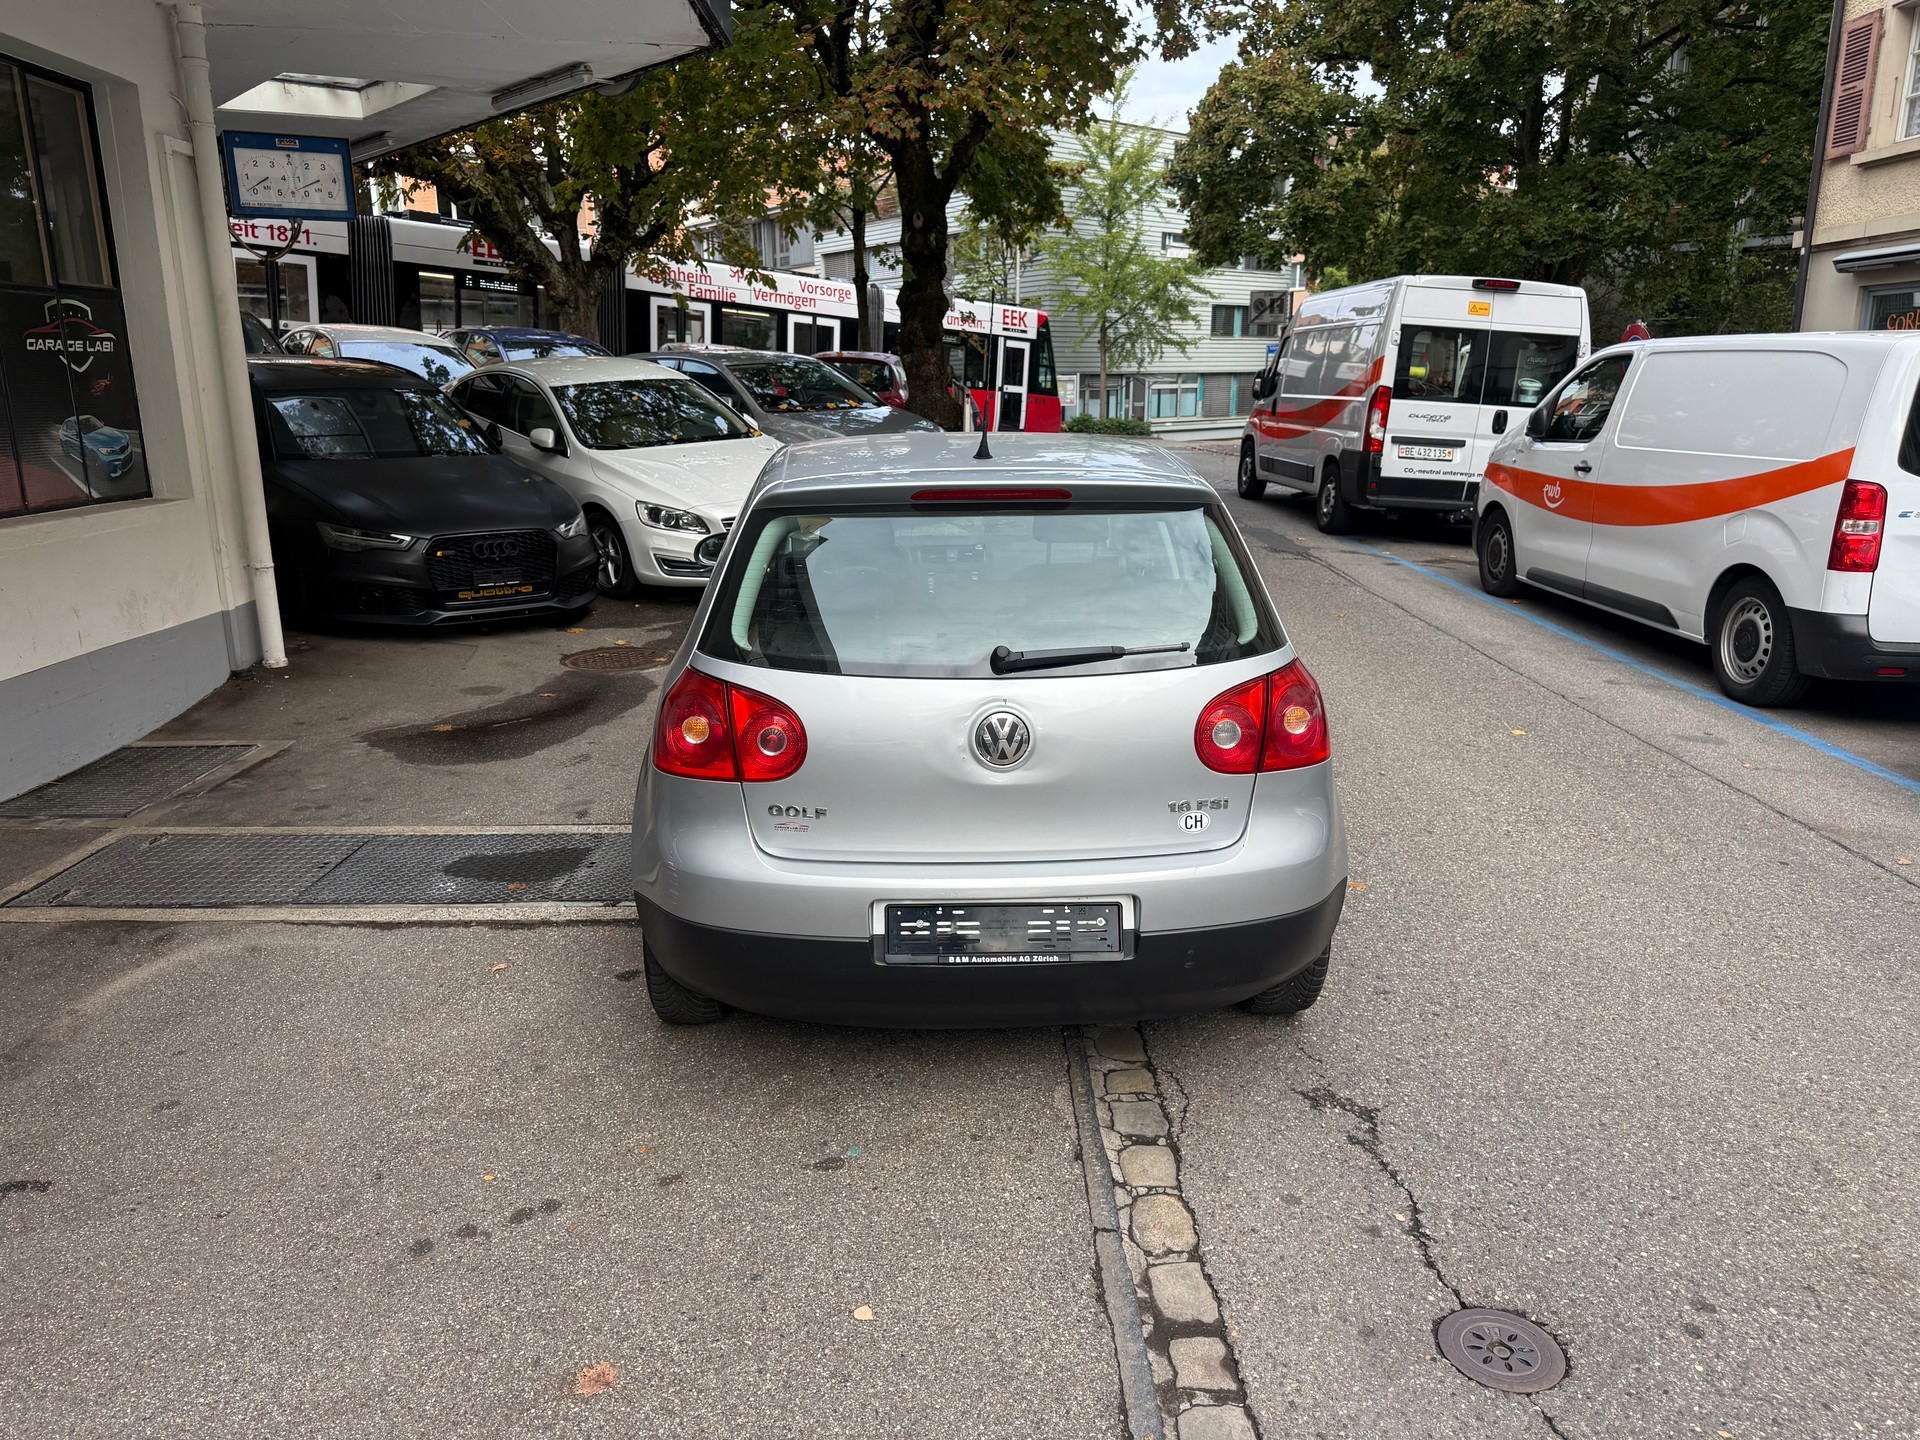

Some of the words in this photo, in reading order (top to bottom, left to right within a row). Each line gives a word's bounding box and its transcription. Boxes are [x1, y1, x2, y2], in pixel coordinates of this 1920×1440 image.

[270, 160, 275, 168] 3
[321, 163, 326, 171] 3
[281, 174, 286, 182] 4
[332, 177, 337, 185] 4
[328, 191, 333, 199] 5
[232, 220, 259, 239] eit
[266, 224, 317, 246] 181.
[689, 284, 737, 303] Familie
[753, 287, 816, 309] Vermögen
[799, 280, 852, 302] Vorsorge
[1002, 309, 1028, 328] EEK
[26, 338, 84, 352] GARAGE
[86, 341, 114, 352] LABI
[458, 585, 533, 599] quattro
[767, 804, 828, 820] GOLF
[1184, 814, 1203, 830] CH
